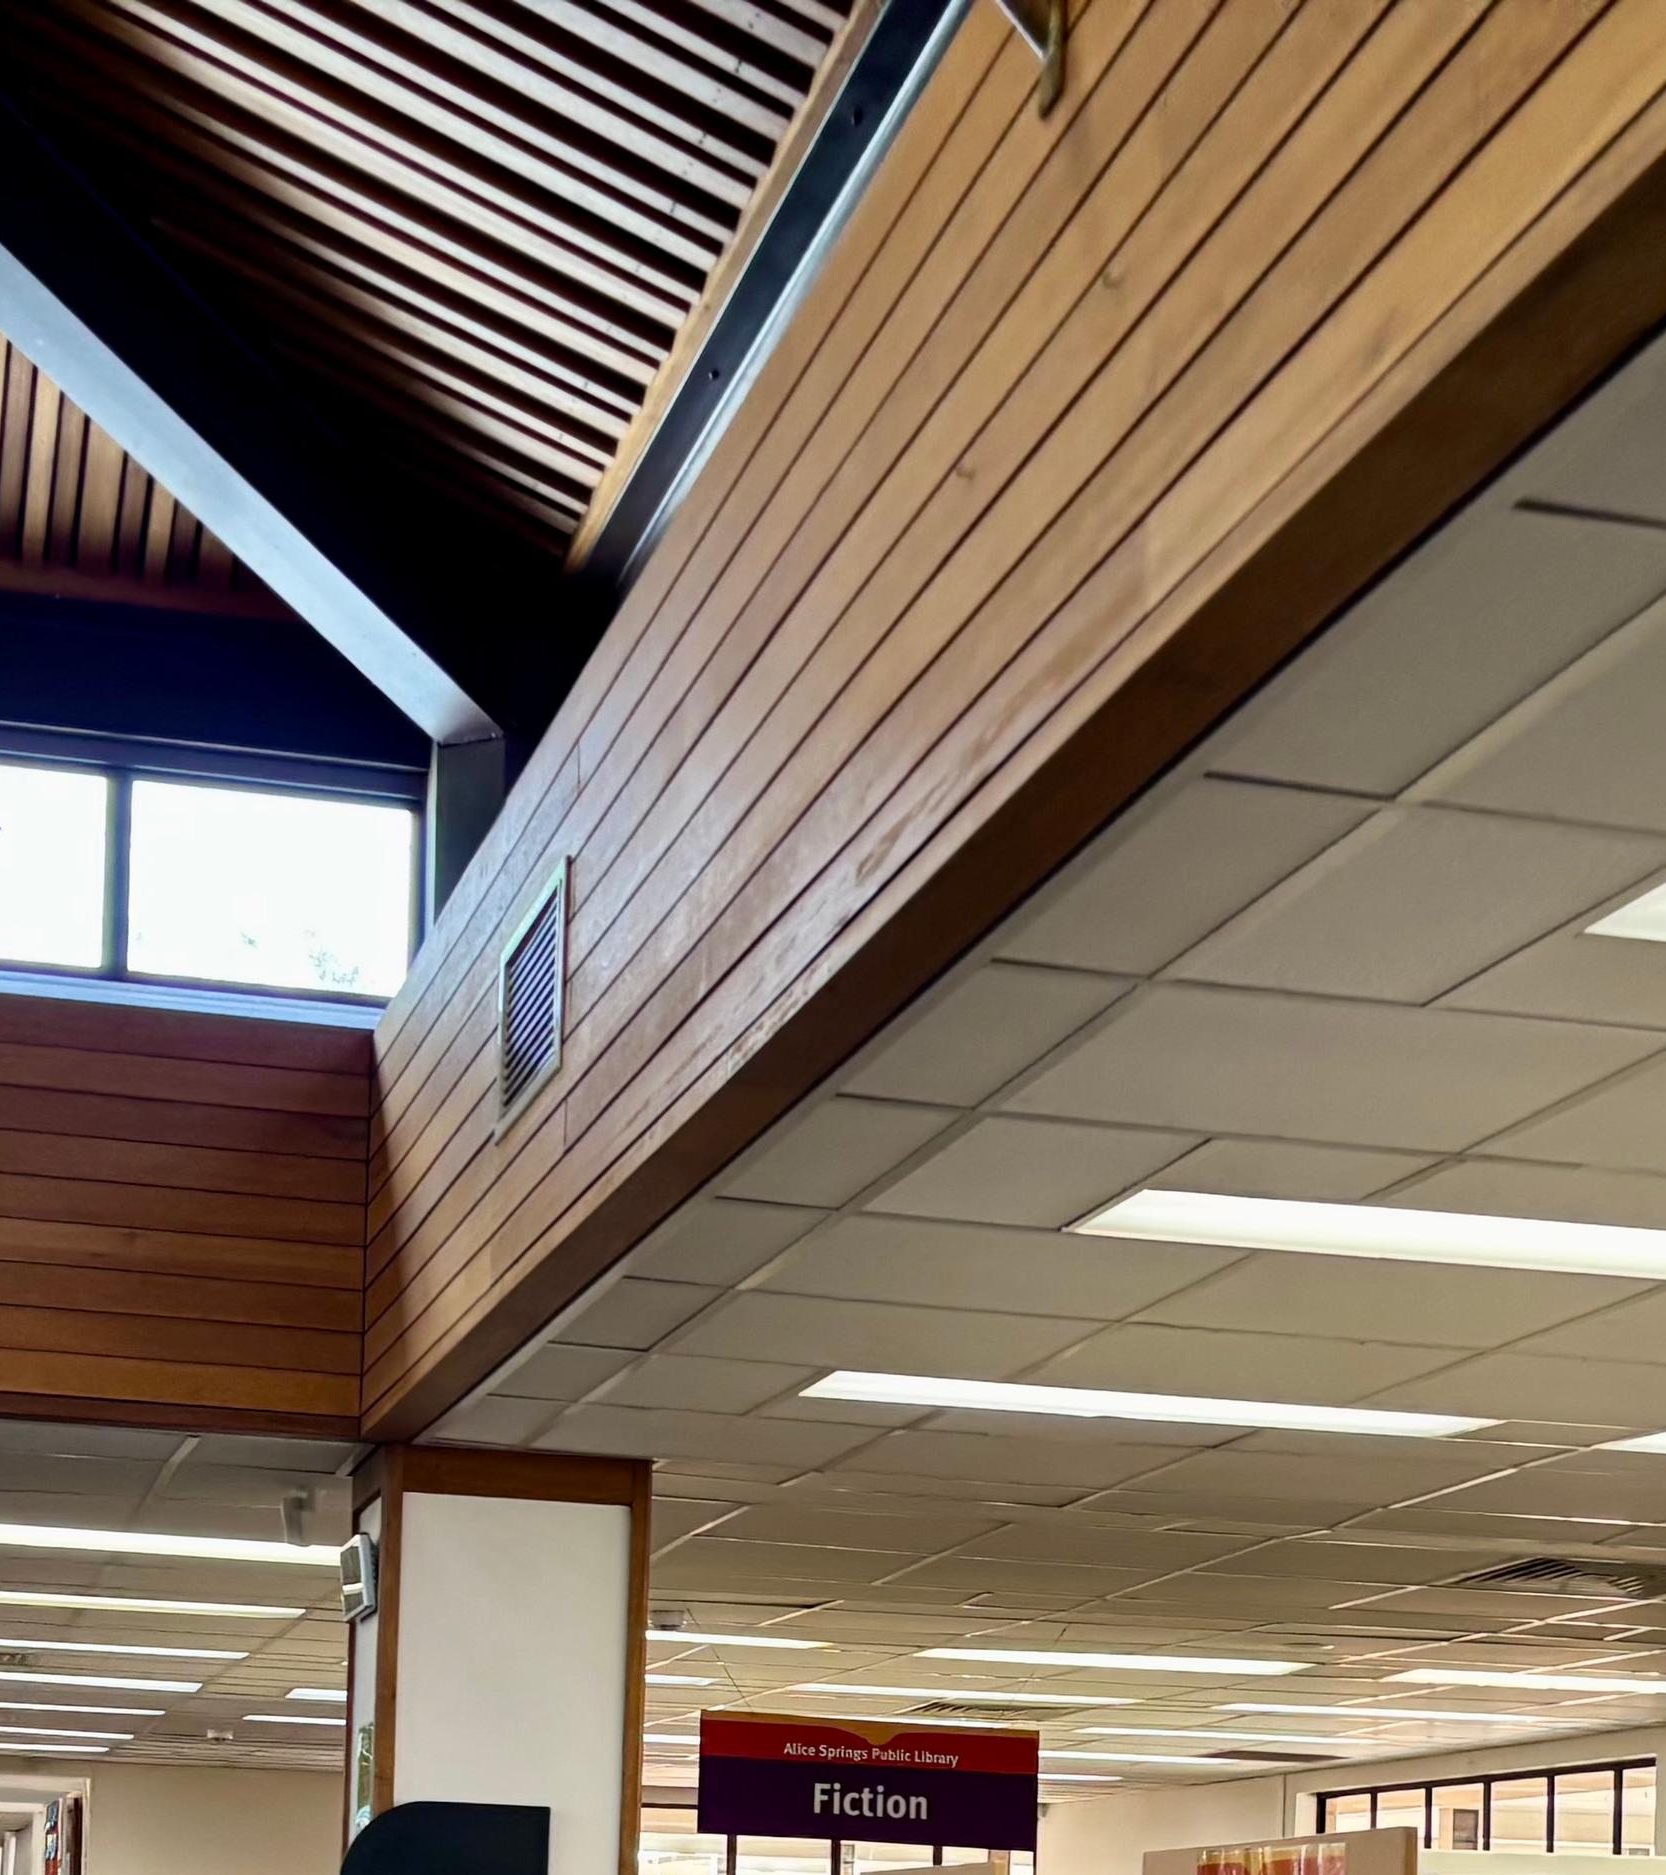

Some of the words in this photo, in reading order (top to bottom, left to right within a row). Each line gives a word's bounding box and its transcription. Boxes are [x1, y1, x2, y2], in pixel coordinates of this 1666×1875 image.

[784, 1742, 816, 1756] Alice
[818, 1744, 869, 1761] Springs
[871, 1747, 912, 1762] Public
[914, 1750, 960, 1768] Library
[813, 1781, 928, 1820] Fiction
